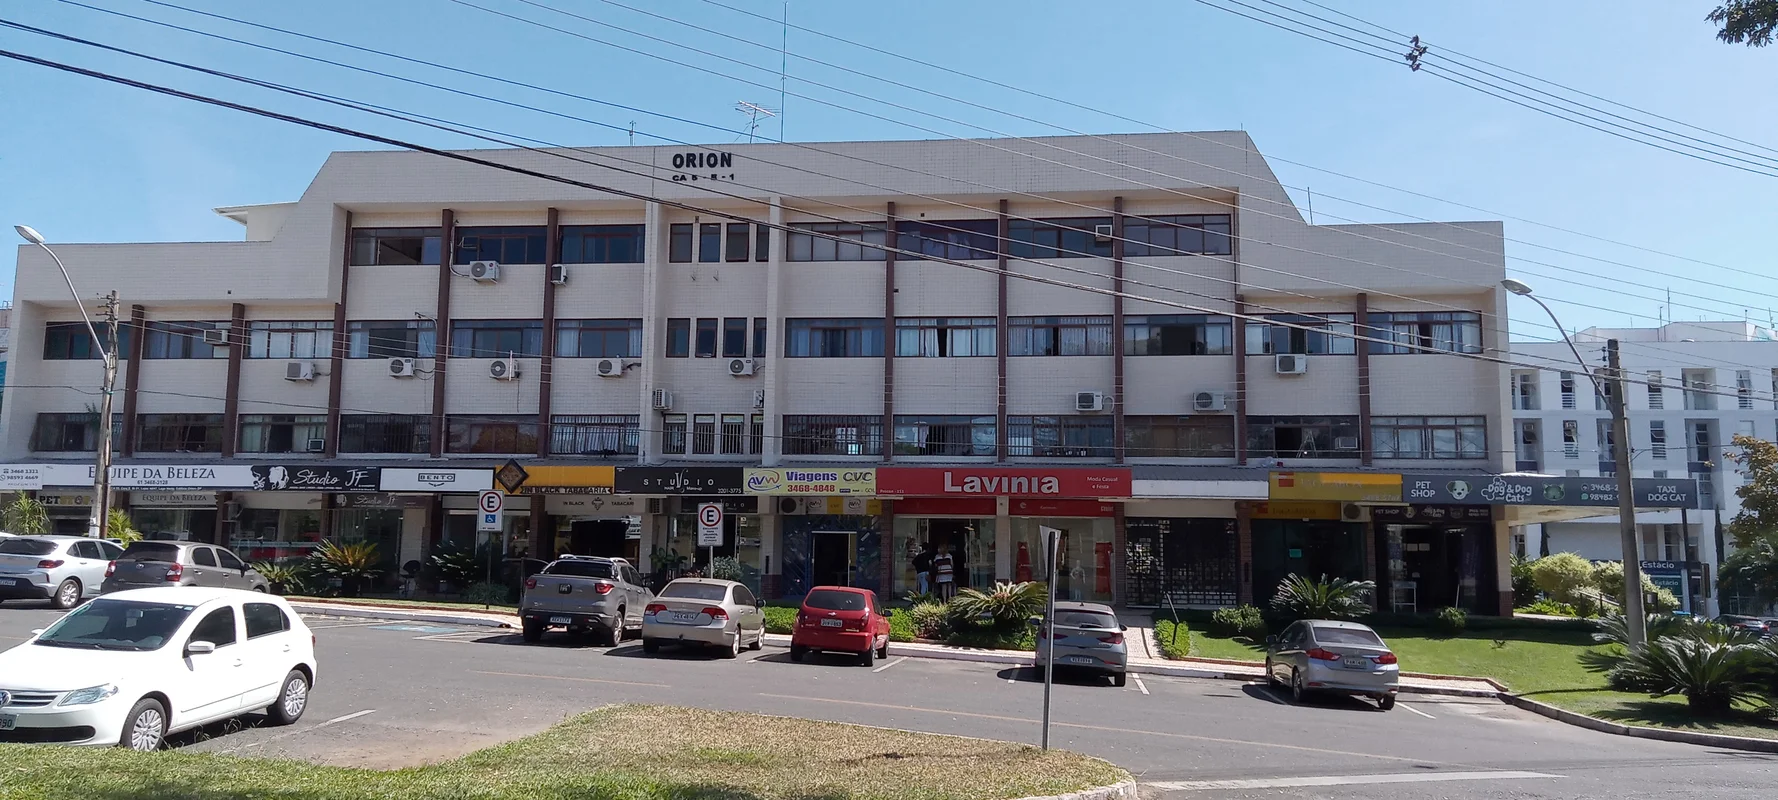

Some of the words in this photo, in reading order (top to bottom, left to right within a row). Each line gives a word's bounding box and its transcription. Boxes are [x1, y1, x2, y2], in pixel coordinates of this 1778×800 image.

[672, 152, 732, 168] ORION
[729, 173, 735, 181] 1
[88, 466, 138, 478] EUIPE
[143, 467, 162, 478] DA
[167, 466, 216, 478] BELEZA
[785, 471, 838, 483] Viagens
[842, 471, 873, 482] CVC
[292, 469, 340, 485] Studio
[345, 468, 370, 487] JF
[944, 471, 1059, 494] Lavinia
[787, 484, 836, 493] 3468-4848
[1415, 481, 1431, 489] PET
[1488, 484, 1505, 496] Dog
[1506, 484, 1514, 493] &
[1515, 484, 1532, 496] Dog
[1656, 485, 1677, 493] TAXI
[142, 494, 167, 502] EQUIPE
[1410, 489, 1436, 498] SHOP
[1505, 494, 1525, 502] Cats
[1647, 493, 1668, 502] DOG
[1669, 493, 1687, 502] CAT
[487, 496, 495, 508] E
[706, 510, 715, 522] E
[1642, 561, 1675, 569] Estácio
